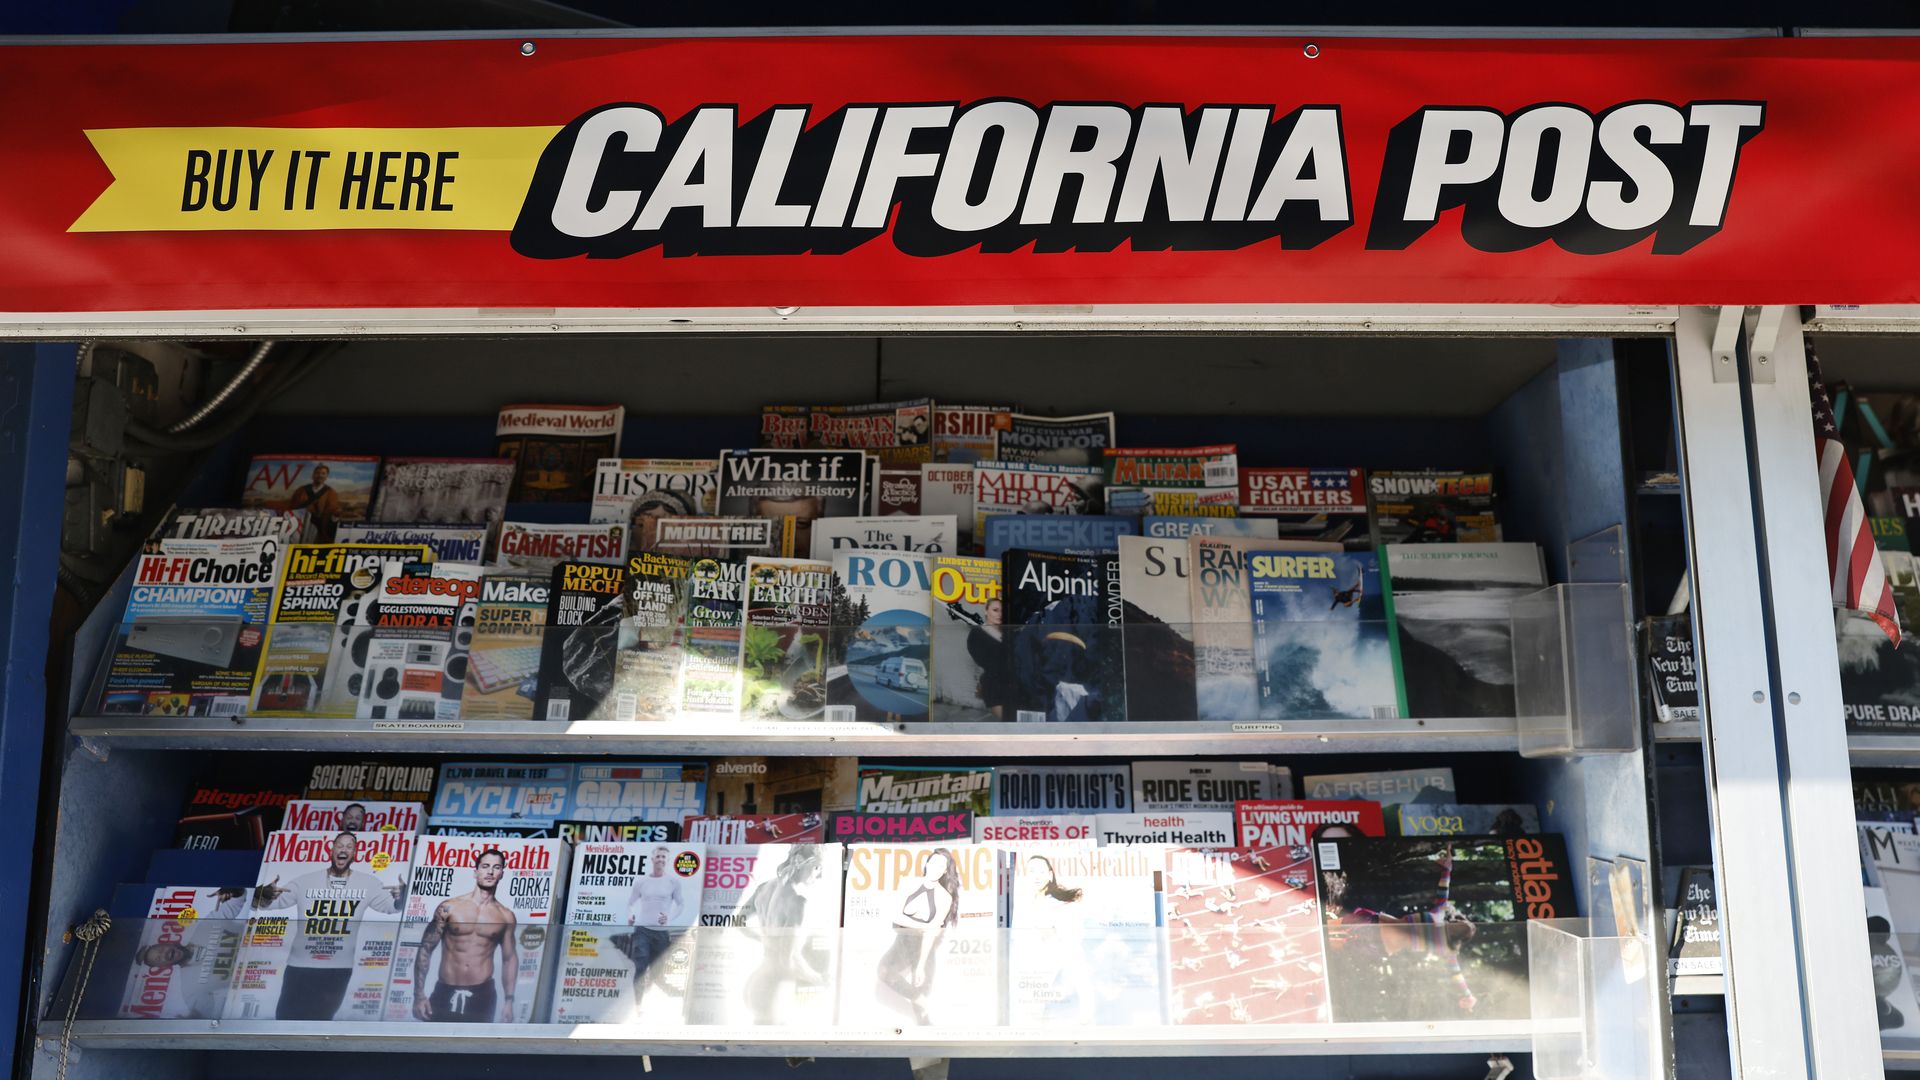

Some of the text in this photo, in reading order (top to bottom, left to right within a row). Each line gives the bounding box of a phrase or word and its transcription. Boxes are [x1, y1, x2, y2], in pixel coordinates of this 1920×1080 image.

[548, 101, 1764, 239] CALIFORNIA POST
[181, 149, 459, 212] BUY IT HERE
[499, 411, 616, 429] Medieval World
[811, 413, 895, 434] BRITAIN
[1015, 425, 1093, 436] THE CIVIL WAR
[822, 432, 895, 448] AT WAR
[1002, 432, 1106, 449] MONITOR
[728, 456, 857, 482] What if...
[1249, 475, 1307, 491] USAF
[1371, 475, 1489, 496] SNOW TECH
[725, 485, 856, 499] Alternative History
[1154, 491, 1234, 505] VISIT SPECIAL
[1249, 490, 1353, 505] FIGHTERS
[1155, 503, 1237, 517] WALLONIA
[175, 512, 299, 543] THRASHER
[365, 530, 435, 541] Pacific Coast
[664, 525, 764, 541] MOULTRIE
[864, 529, 893, 542] The
[1150, 522, 1215, 537] GREAT
[501, 531, 623, 559] GAME&FISH
[290, 548, 346, 573] hi-fi
[1144, 546, 1189, 578] Su
[1252, 555, 1336, 579] SURFER
[139, 557, 274, 584] Hi-Fi Choice
[1200, 567, 1240, 588] ON
[636, 581, 672, 594] LIVING
[777, 569, 831, 590] MOTH
[931, 566, 1002, 604] Out
[133, 587, 247, 605] CHAMPION!
[285, 583, 344, 598] STEREO
[632, 590, 674, 604] OFF THE
[753, 584, 817, 605] EARTH
[1107, 560, 1121, 629] POWDER
[281, 598, 340, 611] SPHINX
[379, 604, 455, 616] EGGLESTONWORKS
[559, 595, 597, 612] BUILDING
[638, 600, 667, 612] LAND
[377, 614, 453, 628] ANDRA 5
[480, 608, 532, 622] SUPER
[557, 610, 584, 626] BLOCK
[693, 605, 735, 620] Grow
[692, 618, 733, 628] in Your
[1665, 635, 1693, 654] The
[1651, 656, 1679, 673] New
[1673, 709, 1697, 719] SALE
[1843, 703, 1886, 721] PURE
[528, 768, 548, 779] TEST
[716, 762, 767, 775] alvento
[309, 764, 435, 792] SCIENCE CYCLING
[861, 770, 992, 802] Mountain
[1333, 775, 1447, 797] FREEHUB
[191, 788, 299, 810] Bicycling
[437, 781, 568, 817] CYCLING
[577, 781, 700, 808] GRAVEL
[951, 791, 973, 804] UK
[1000, 773, 1125, 809] ROAD CYCLIST'S
[1142, 779, 1261, 803] RIDE GUIDE
[285, 803, 417, 831] Men's ealth
[836, 814, 967, 836] BIOHACK
[1143, 816, 1185, 828] health
[1241, 811, 1360, 825] LIVING WITHOUT
[1407, 815, 1464, 834] yoga
[557, 824, 668, 844] RUNNER'S
[983, 825, 1089, 841] SECRETS OF
[1104, 831, 1167, 848] Thyroid
[1171, 830, 1226, 844] Health
[1243, 825, 1307, 848] PAIN
[271, 832, 411, 864] Men's ealth
[424, 840, 479, 869] Men's
[581, 854, 648, 876] MUSCLE
[705, 856, 758, 873] BEST
[1089, 850, 1149, 877] Health
[414, 866, 454, 883] WINTER
[579, 875, 635, 887] AFTER FORTY
[1514, 838, 1558, 920] atlas
[305, 888, 367, 899] UNSTOPPABLE
[410, 881, 451, 897] MUSCLE
[509, 877, 550, 897] GORKA
[1686, 883, 1711, 903] The
[304, 899, 361, 918] JELLY
[513, 896, 549, 910] MARQUEZ
[257, 917, 289, 926] OLYMPIC
[574, 912, 612, 922] FAT BLASTER
[254, 925, 286, 935] MUSCLE!
[304, 917, 353, 935] ROLL
[570, 936, 598, 944] Sweaty
[948, 939, 993, 955] 2026
[211, 929, 241, 982] JELLY
[565, 967, 629, 979] NO-EQUIPMENT
[1690, 961, 1715, 970] SALE
[563, 977, 617, 988] NO-EXCUSES
[562, 987, 620, 999] MUSCLE PLAN
